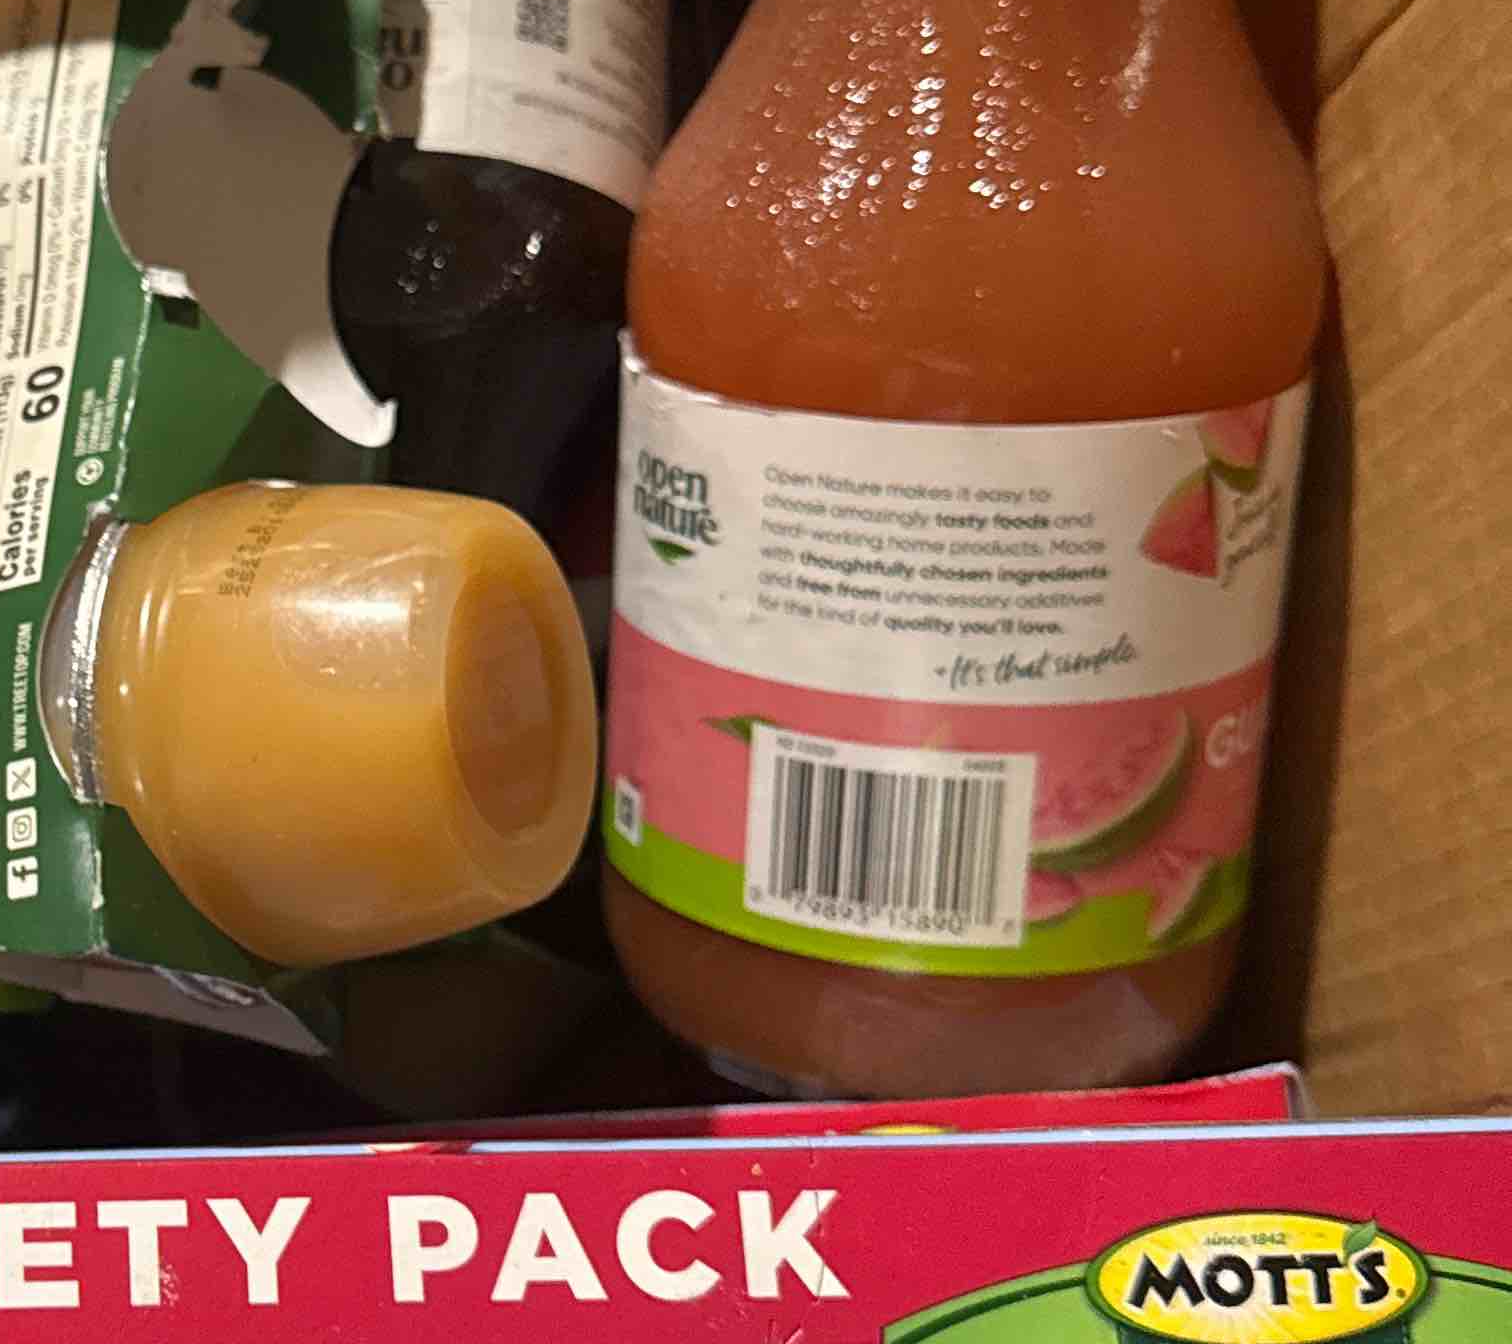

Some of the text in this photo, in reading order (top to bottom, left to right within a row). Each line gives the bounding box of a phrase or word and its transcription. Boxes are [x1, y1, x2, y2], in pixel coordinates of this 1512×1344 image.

[21, 364, 65, 424] 60
[638, 449, 708, 506] open
[634, 485, 720, 546] nature
[935, 513, 1050, 531] tasty foods
[800, 550, 1110, 586] thoughtfully chosen ingredients
[386, 1188, 852, 1304] PACK
[1204, 1231, 1287, 1247] since 1842
